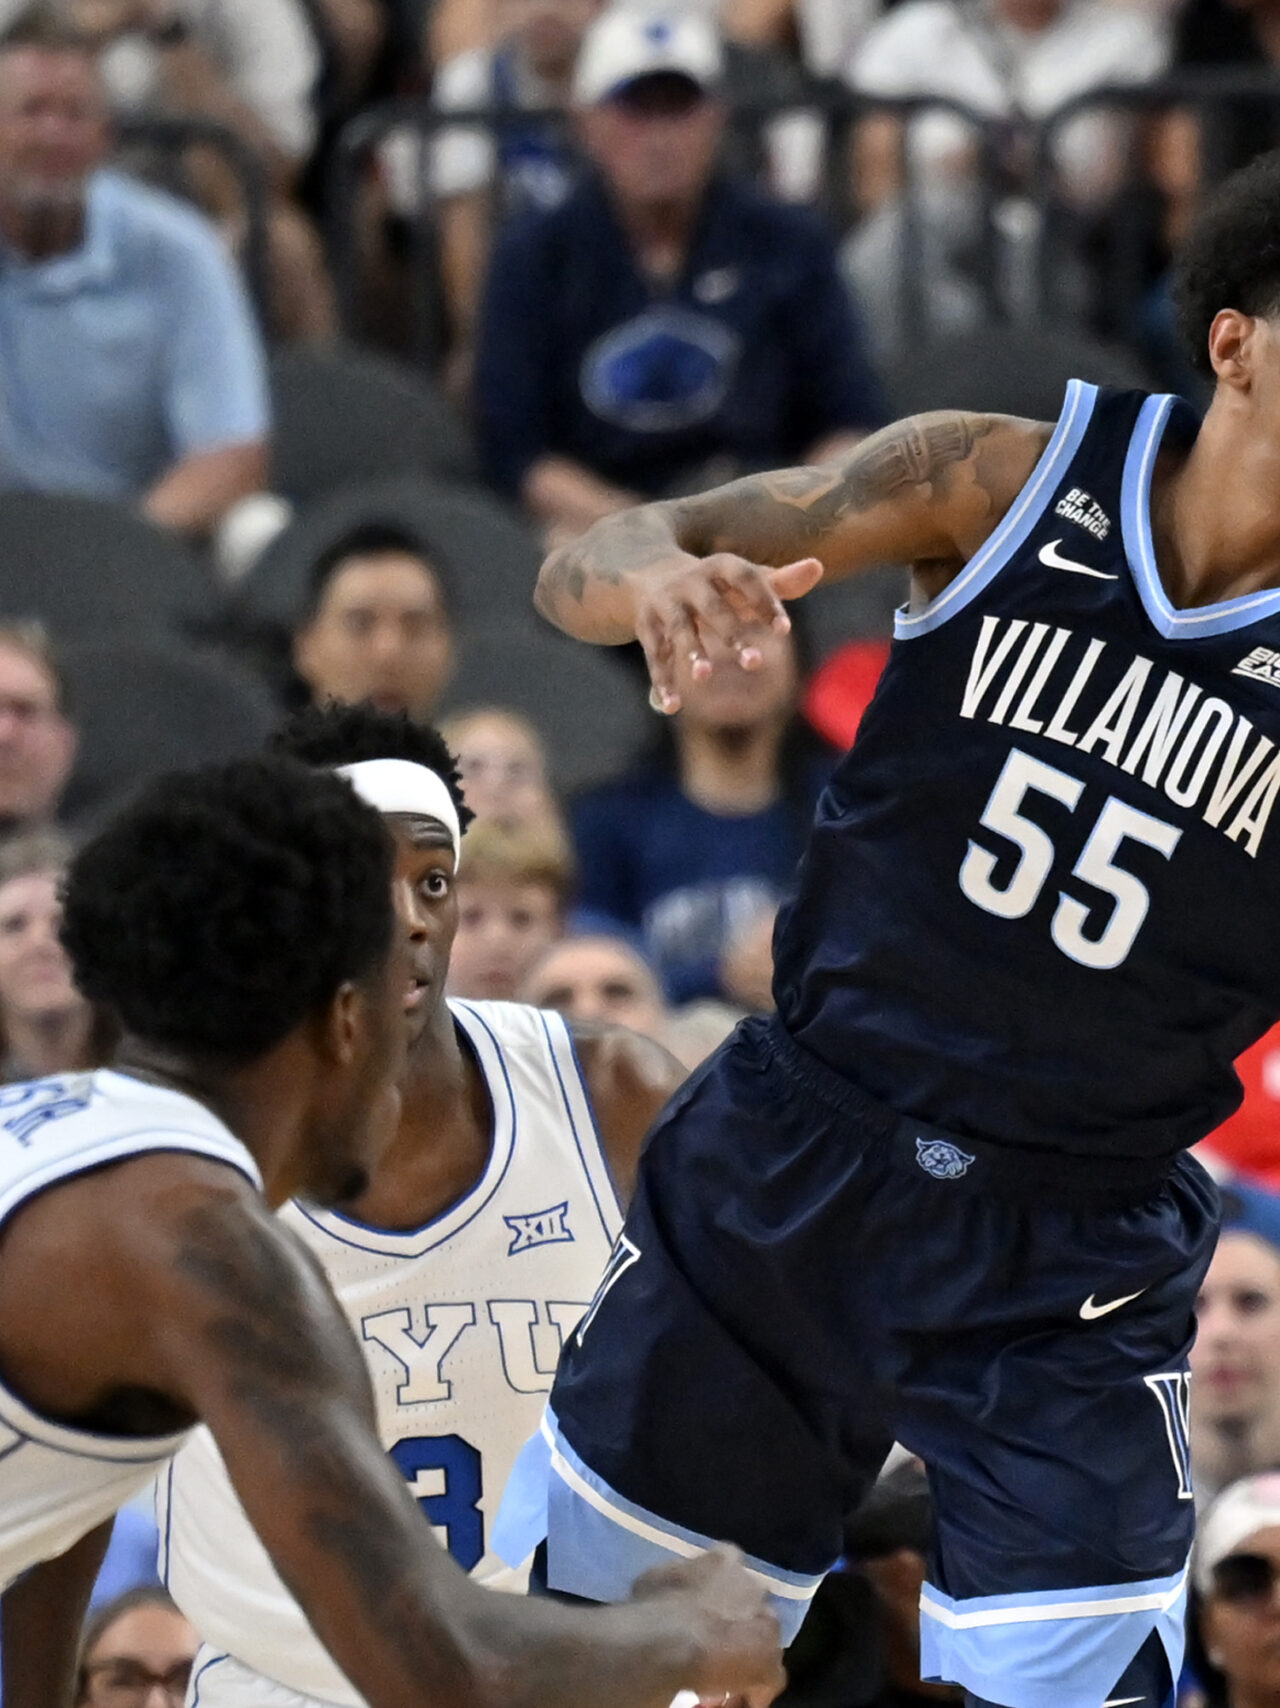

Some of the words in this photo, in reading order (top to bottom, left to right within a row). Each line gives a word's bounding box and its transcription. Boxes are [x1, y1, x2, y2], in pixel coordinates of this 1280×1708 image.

[1055, 499, 1109, 541] CHANGE
[1065, 488, 1091, 507] BE
[1088, 502, 1111, 528] THE
[958, 747, 1184, 970] 55
[361, 1299, 592, 1405] YU
